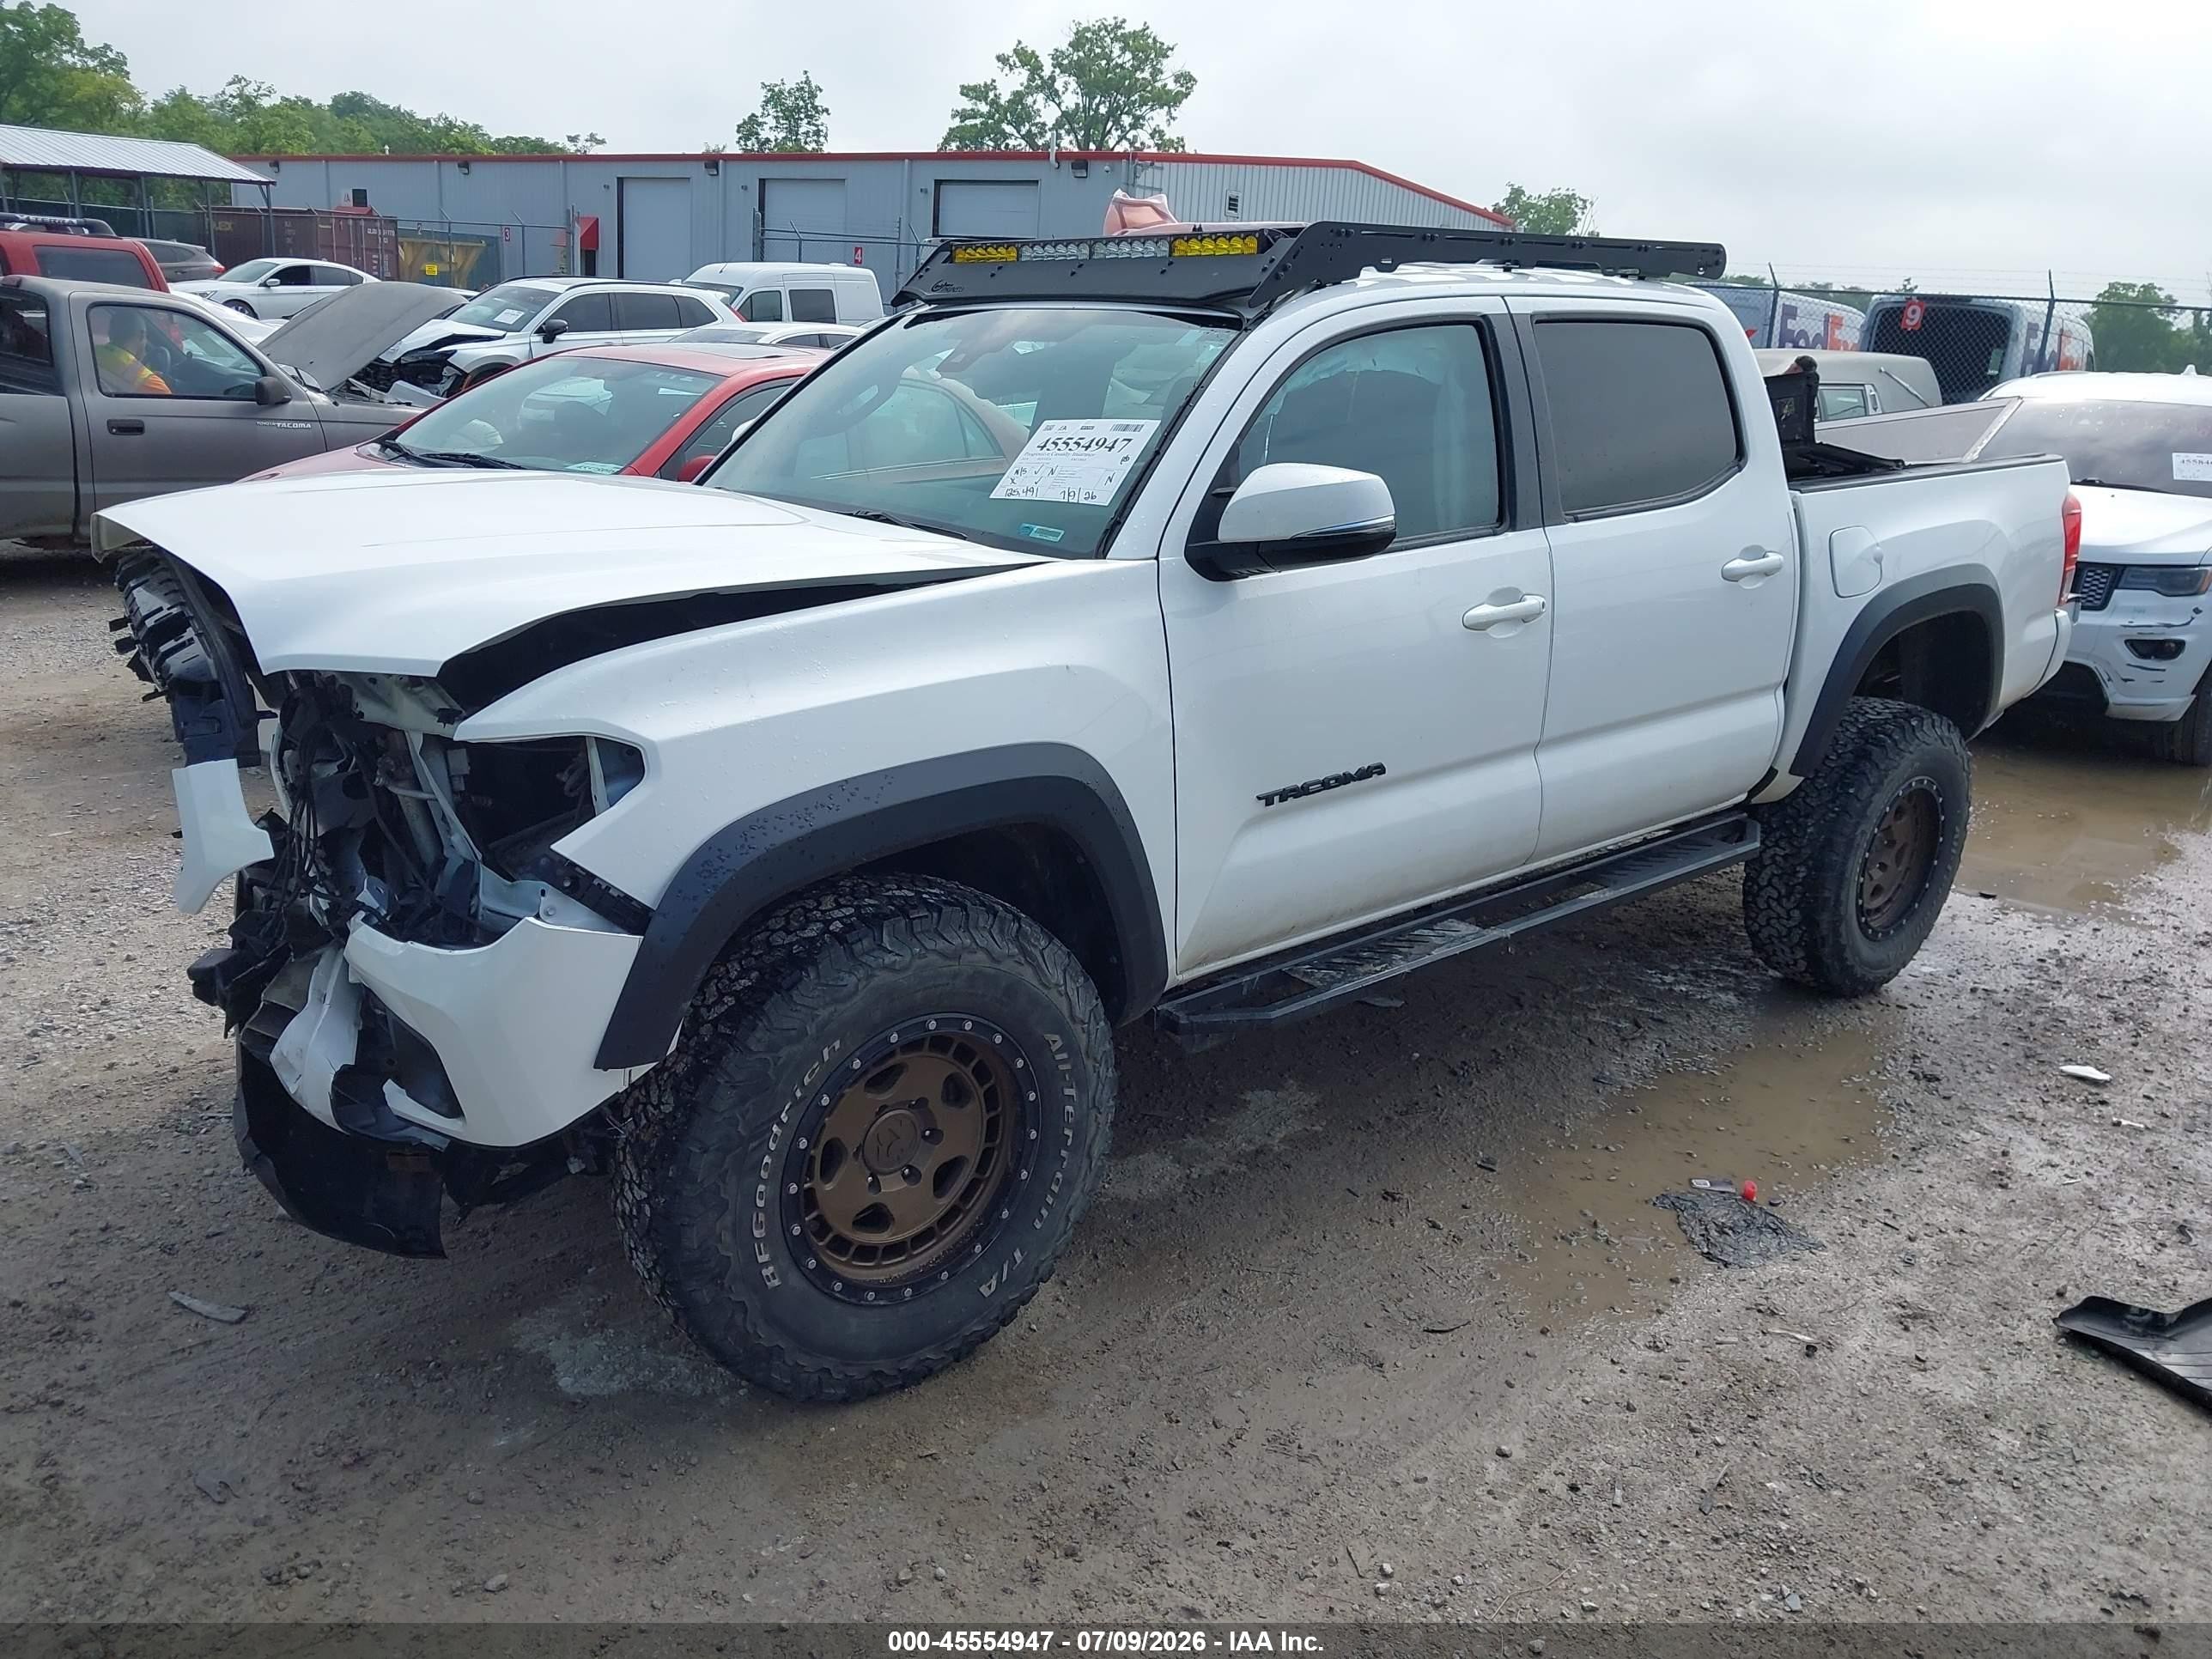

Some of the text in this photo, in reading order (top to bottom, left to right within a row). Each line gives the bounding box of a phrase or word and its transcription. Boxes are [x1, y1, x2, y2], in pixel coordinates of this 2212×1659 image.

[505, 228, 510, 240] 3
[854, 248, 862, 263] 4
[1905, 304, 1922, 325] 9
[1036, 436, 1133, 453] 45554947
[1255, 762, 1387, 807] TACOMA
[752, 1039, 842, 1289] BFGoodrich
[979, 1033, 1077, 1297] All-Terrain T/A
